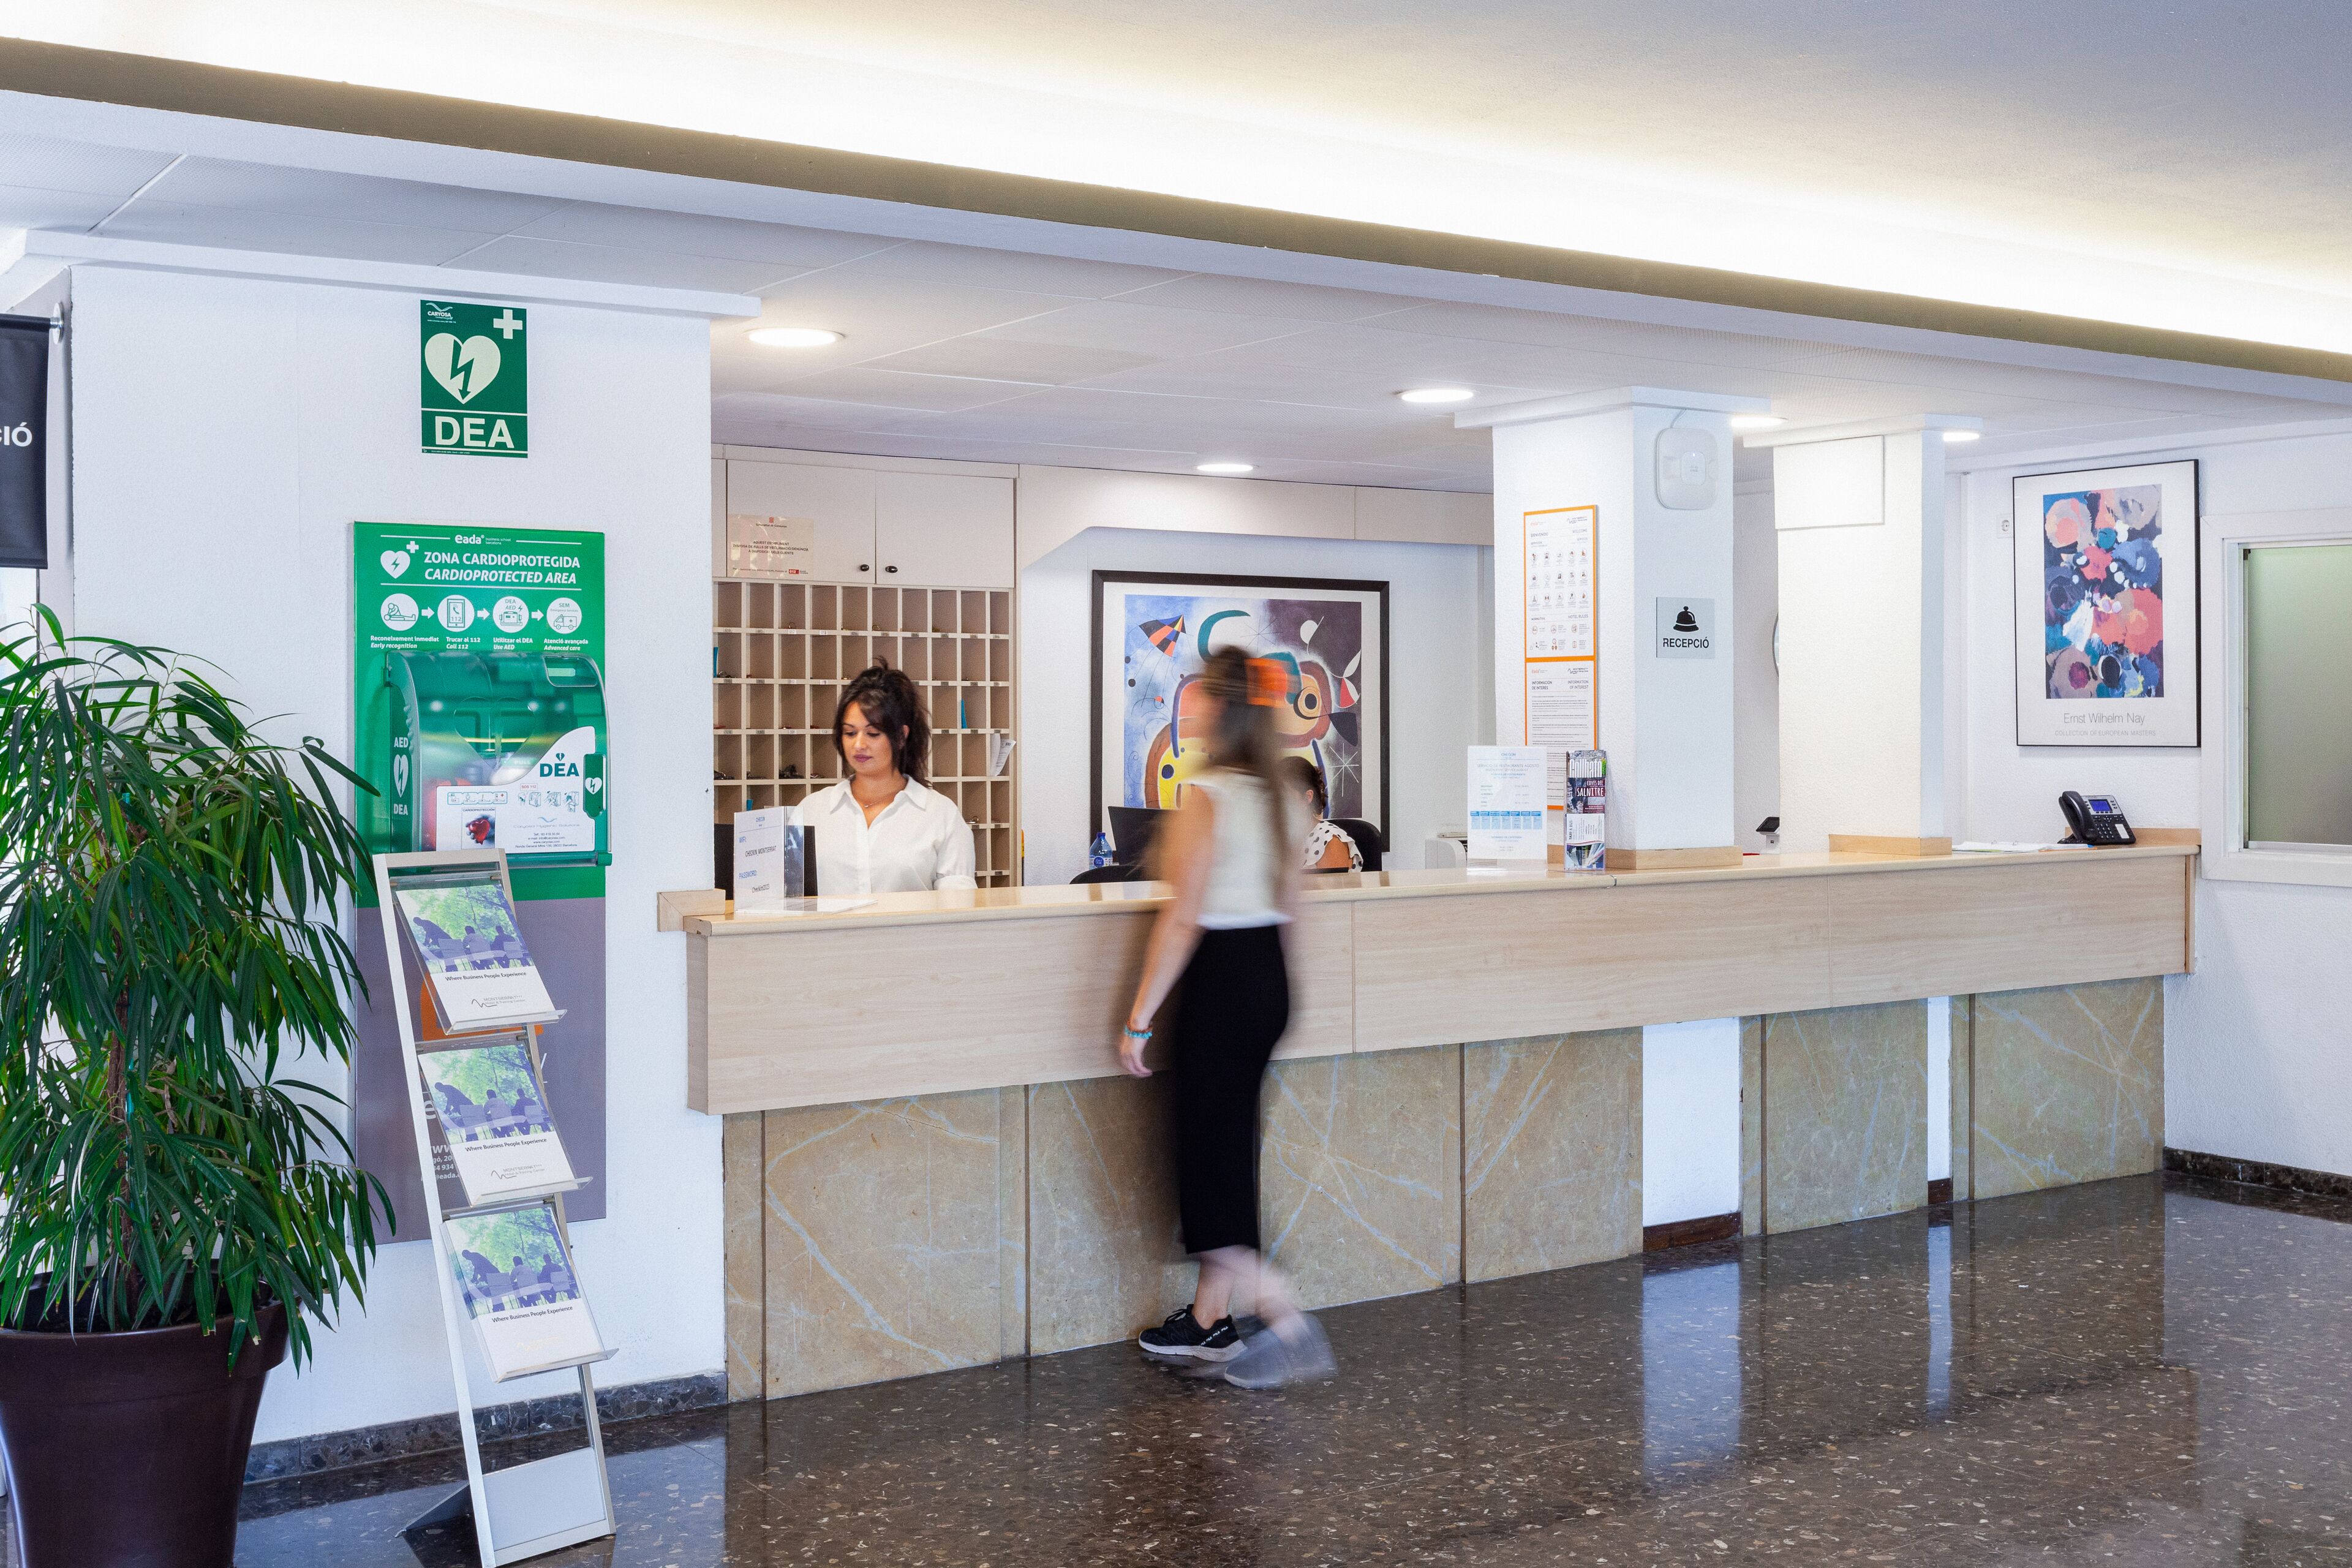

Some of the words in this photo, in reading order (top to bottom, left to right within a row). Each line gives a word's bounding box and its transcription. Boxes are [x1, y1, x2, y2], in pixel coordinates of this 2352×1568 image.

[0, 421, 32, 447] IÓ
[435, 416, 514, 448] DEA
[424, 552, 459, 564] ZONA
[462, 553, 581, 568] CARDIOPROTEGIDA
[424, 568, 543, 582] CARDIOPROTECTED
[545, 572, 576, 584] AREA
[1662, 636, 1709, 649] RECEPCIÓ
[2064, 712, 2086, 723] Ernst
[2088, 712, 2124, 723] Wilhelm
[2127, 712, 2146, 725] Nay
[394, 737, 409, 748] AED
[540, 763, 579, 777] DEA
[1577, 788, 1604, 796] SALNITRE
[393, 804, 409, 815] DEA
[547, 1306, 573, 1314] Experience
